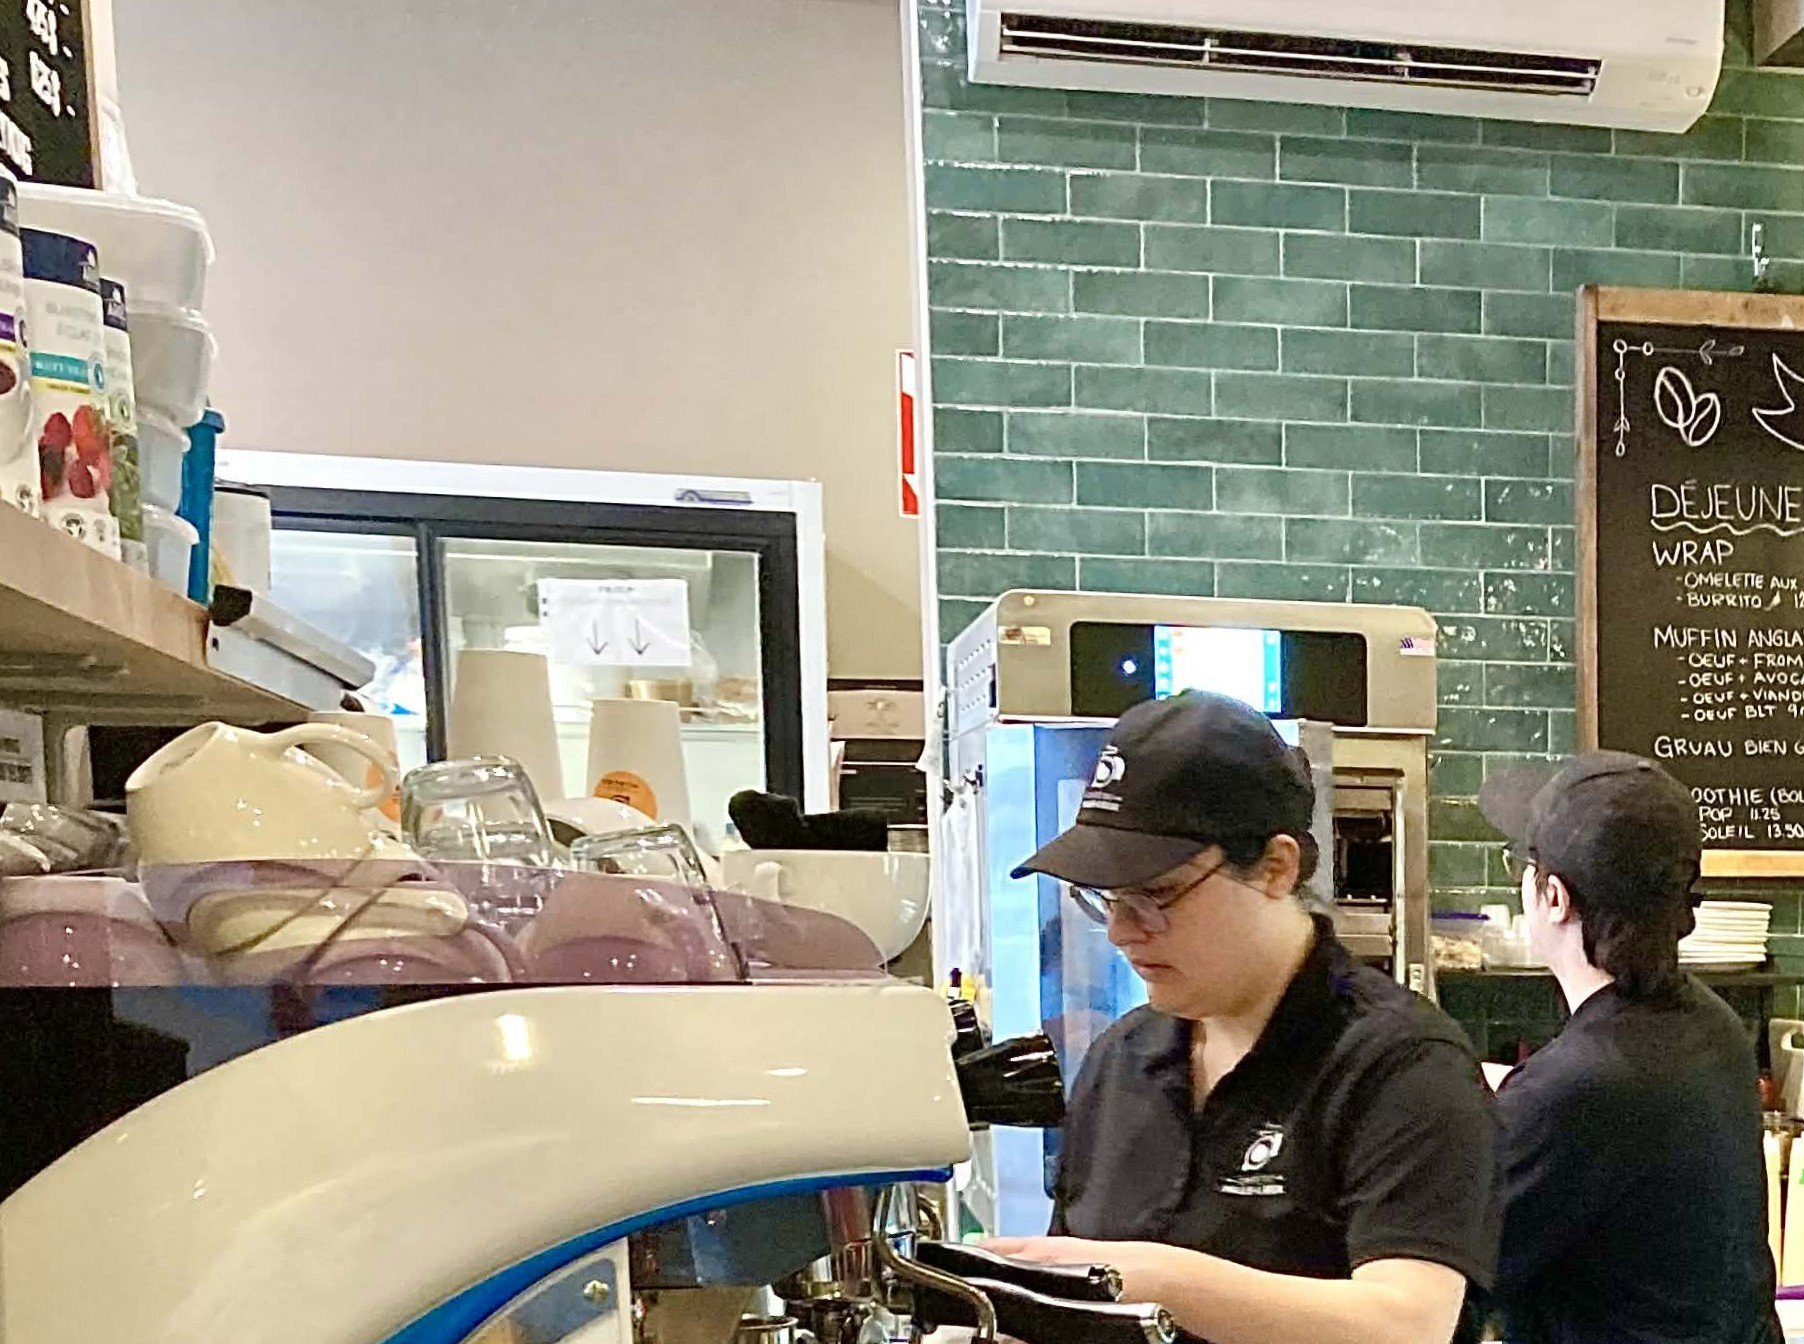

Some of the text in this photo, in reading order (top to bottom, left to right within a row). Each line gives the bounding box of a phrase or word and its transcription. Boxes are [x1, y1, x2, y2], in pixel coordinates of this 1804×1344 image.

[1653, 539, 1734, 566] WRAP
[1684, 572, 1764, 590] OMELETTE
[1769, 577, 1798, 592] AUX
[1687, 592, 1762, 609] BURRITO
[1653, 624, 1737, 649] MUFFIN
[1745, 704, 1777, 719] BLT
[1654, 735, 1733, 759] GRUAU
[1745, 739, 1787, 756] BIEN
[1690, 787, 1765, 807] OOTHIE
[1699, 806, 1733, 822] POP
[1700, 822, 1755, 842] SOLEIL
